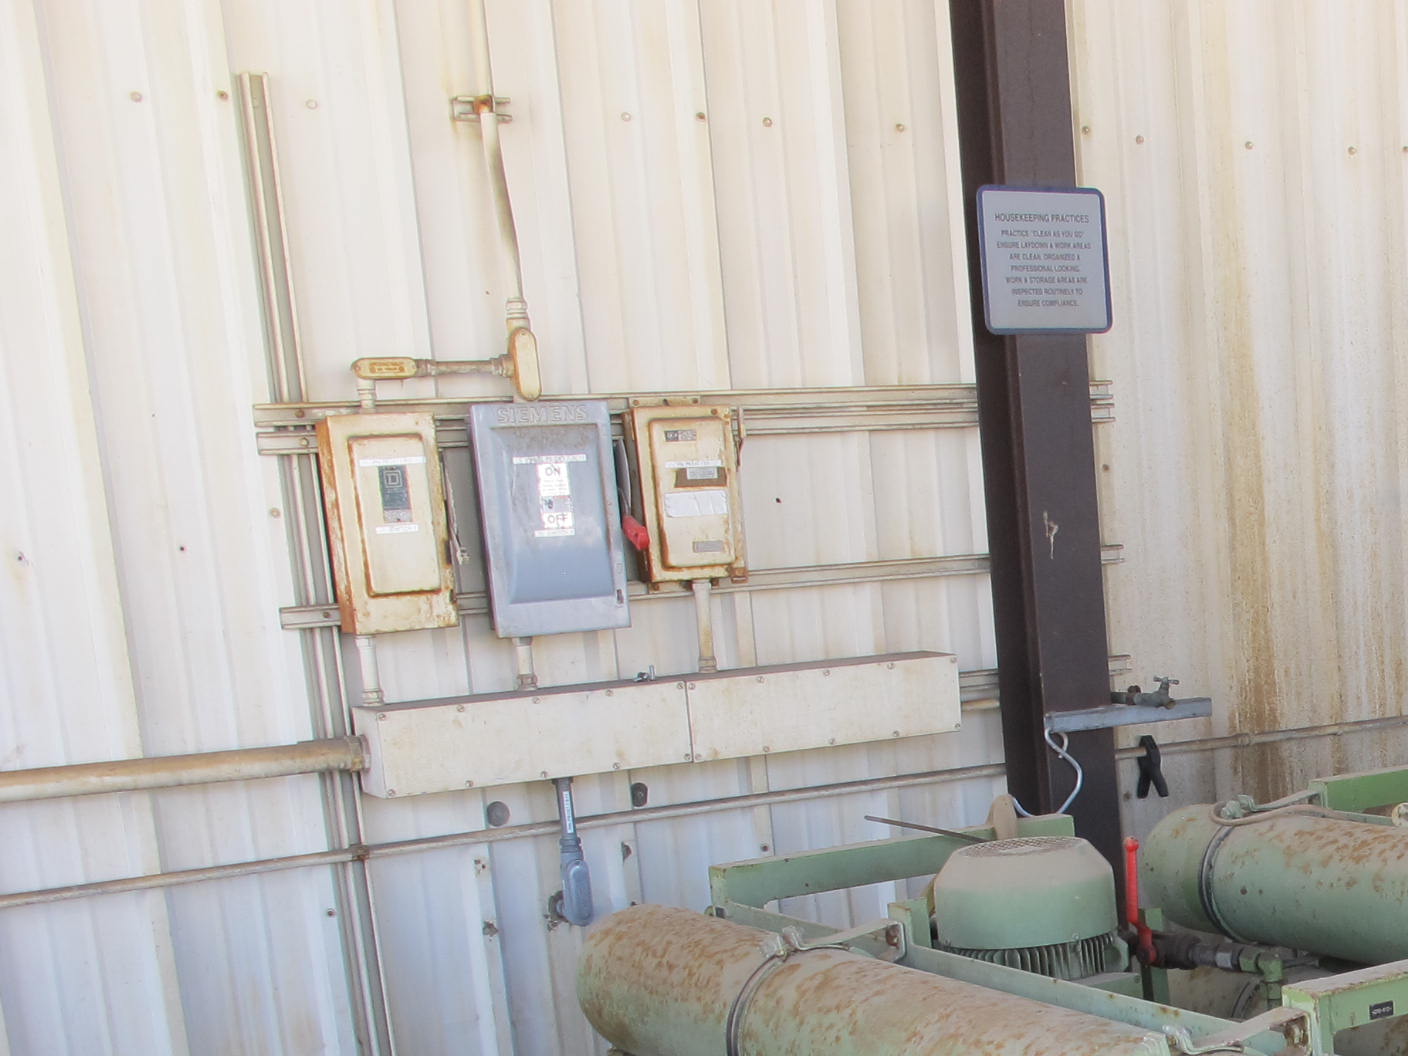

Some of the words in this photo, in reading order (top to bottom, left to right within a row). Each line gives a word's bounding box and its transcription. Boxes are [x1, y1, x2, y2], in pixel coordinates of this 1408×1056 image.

[995, 213, 1050, 222] HOUSEKEEPING
[1051, 214, 1089, 223] PRACTICES
[1010, 265, 1053, 273] PROFESSIONAL
[1018, 299, 1040, 307] ENSURE
[497, 405, 587, 424] SIEMENS
[545, 466, 561, 476] ON
[547, 513, 568, 524] OFF
